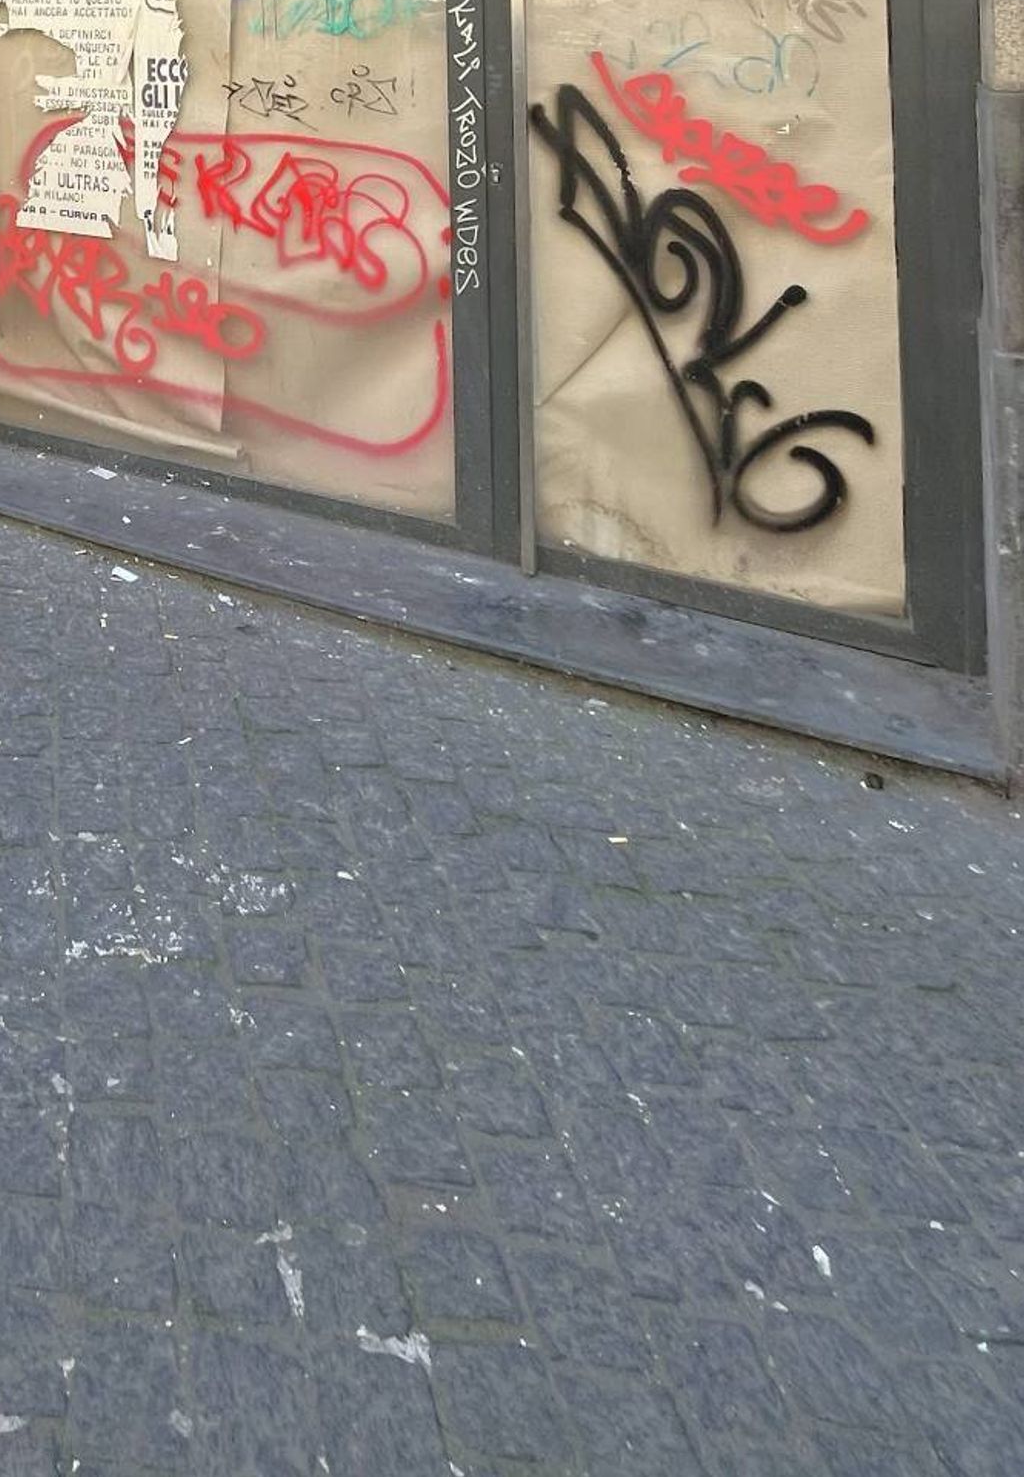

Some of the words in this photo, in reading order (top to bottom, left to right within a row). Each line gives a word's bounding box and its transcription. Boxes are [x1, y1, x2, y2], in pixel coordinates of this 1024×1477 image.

[34, 7, 68, 17] ANCORA
[59, 29, 112, 40] DEFINIRCI
[68, 87, 128, 100] DIMOSTRATO
[59, 209, 98, 221] CURVA
